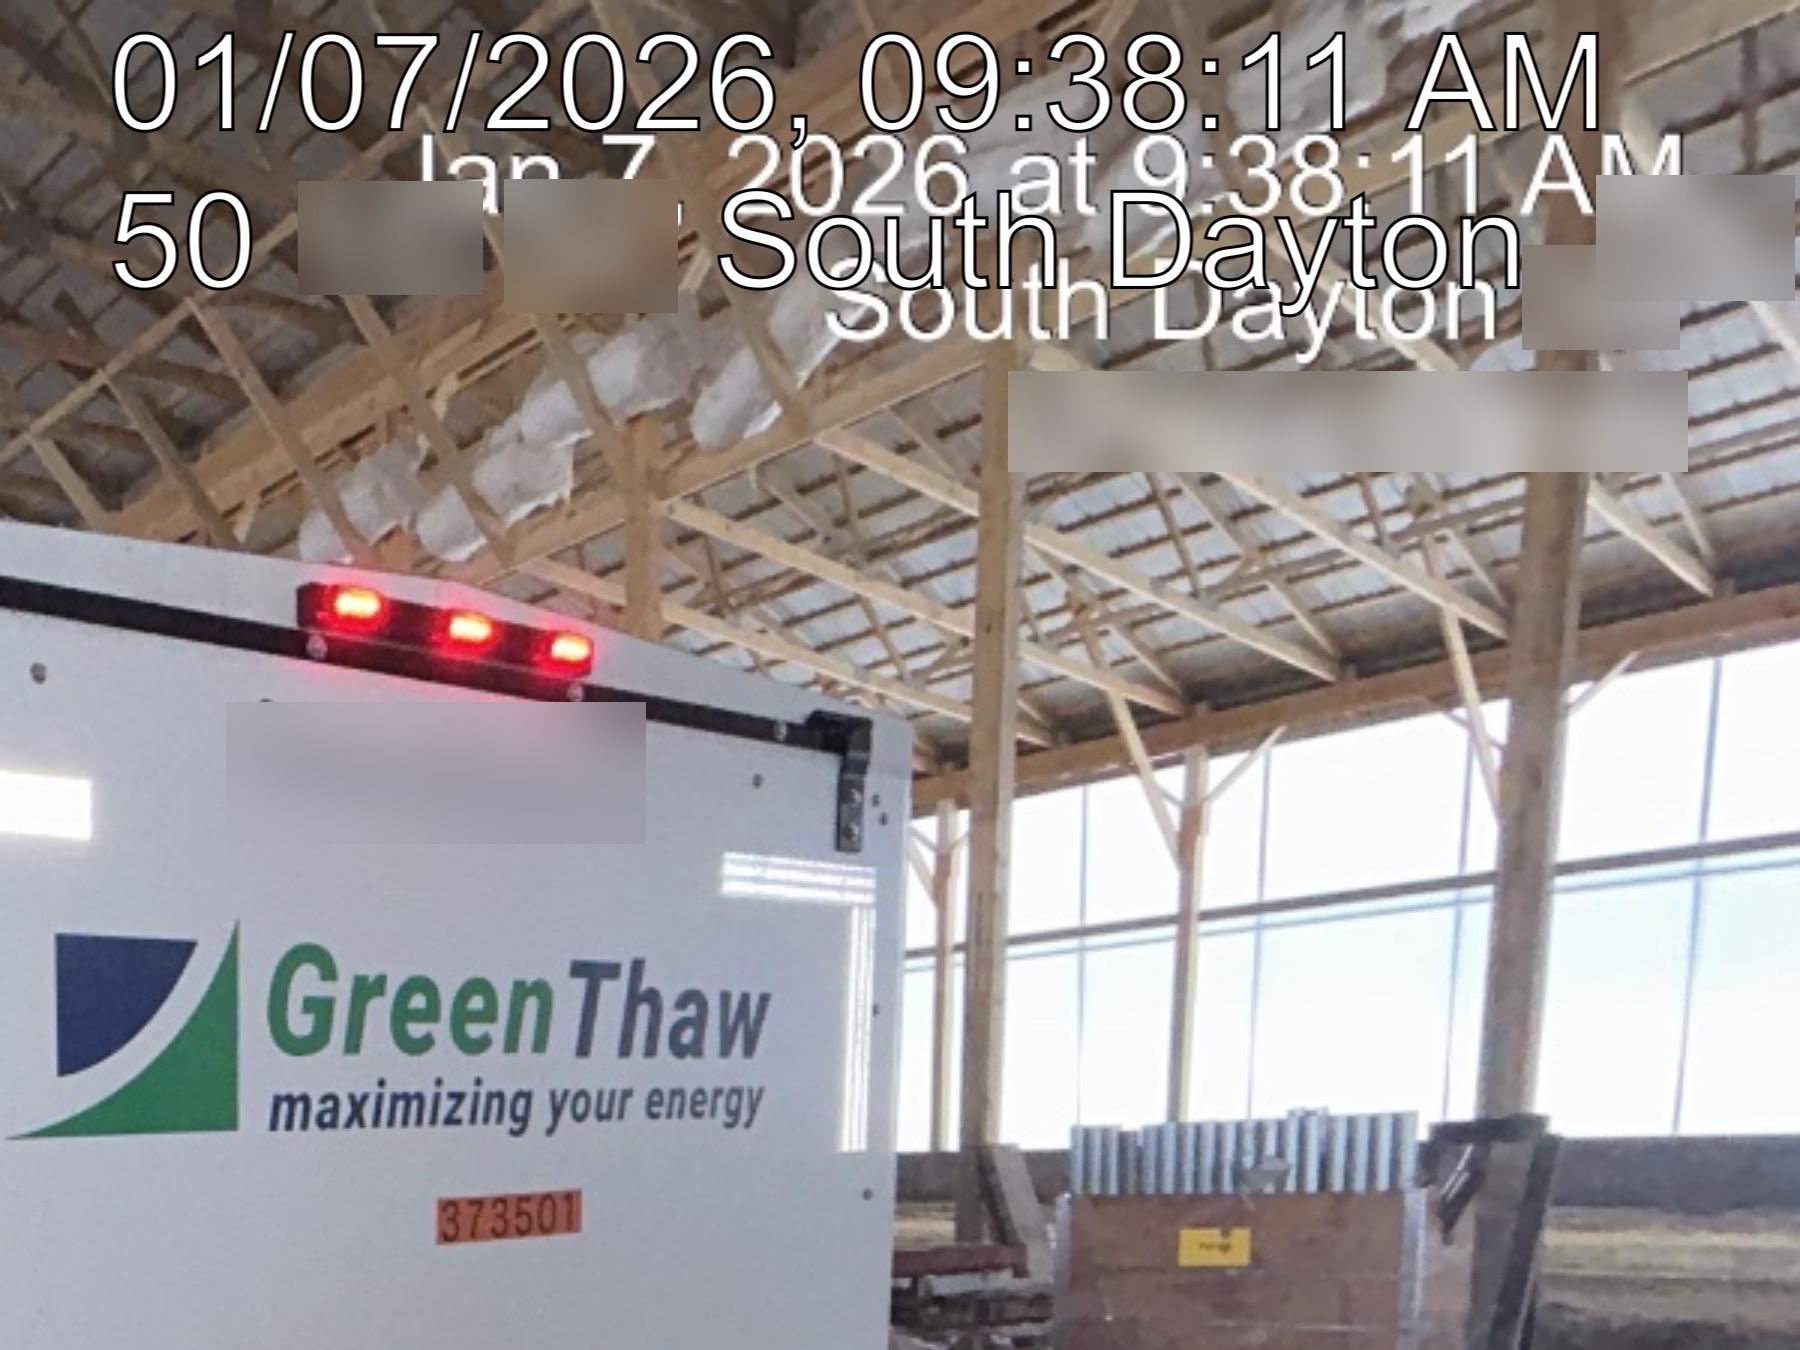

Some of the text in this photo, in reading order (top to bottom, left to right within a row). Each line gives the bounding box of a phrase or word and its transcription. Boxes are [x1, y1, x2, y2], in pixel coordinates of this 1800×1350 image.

[266, 941, 772, 1059] GreenThaw
[268, 1077, 766, 1137] maximizing your energy
[440, 1192, 575, 1243] 373501
